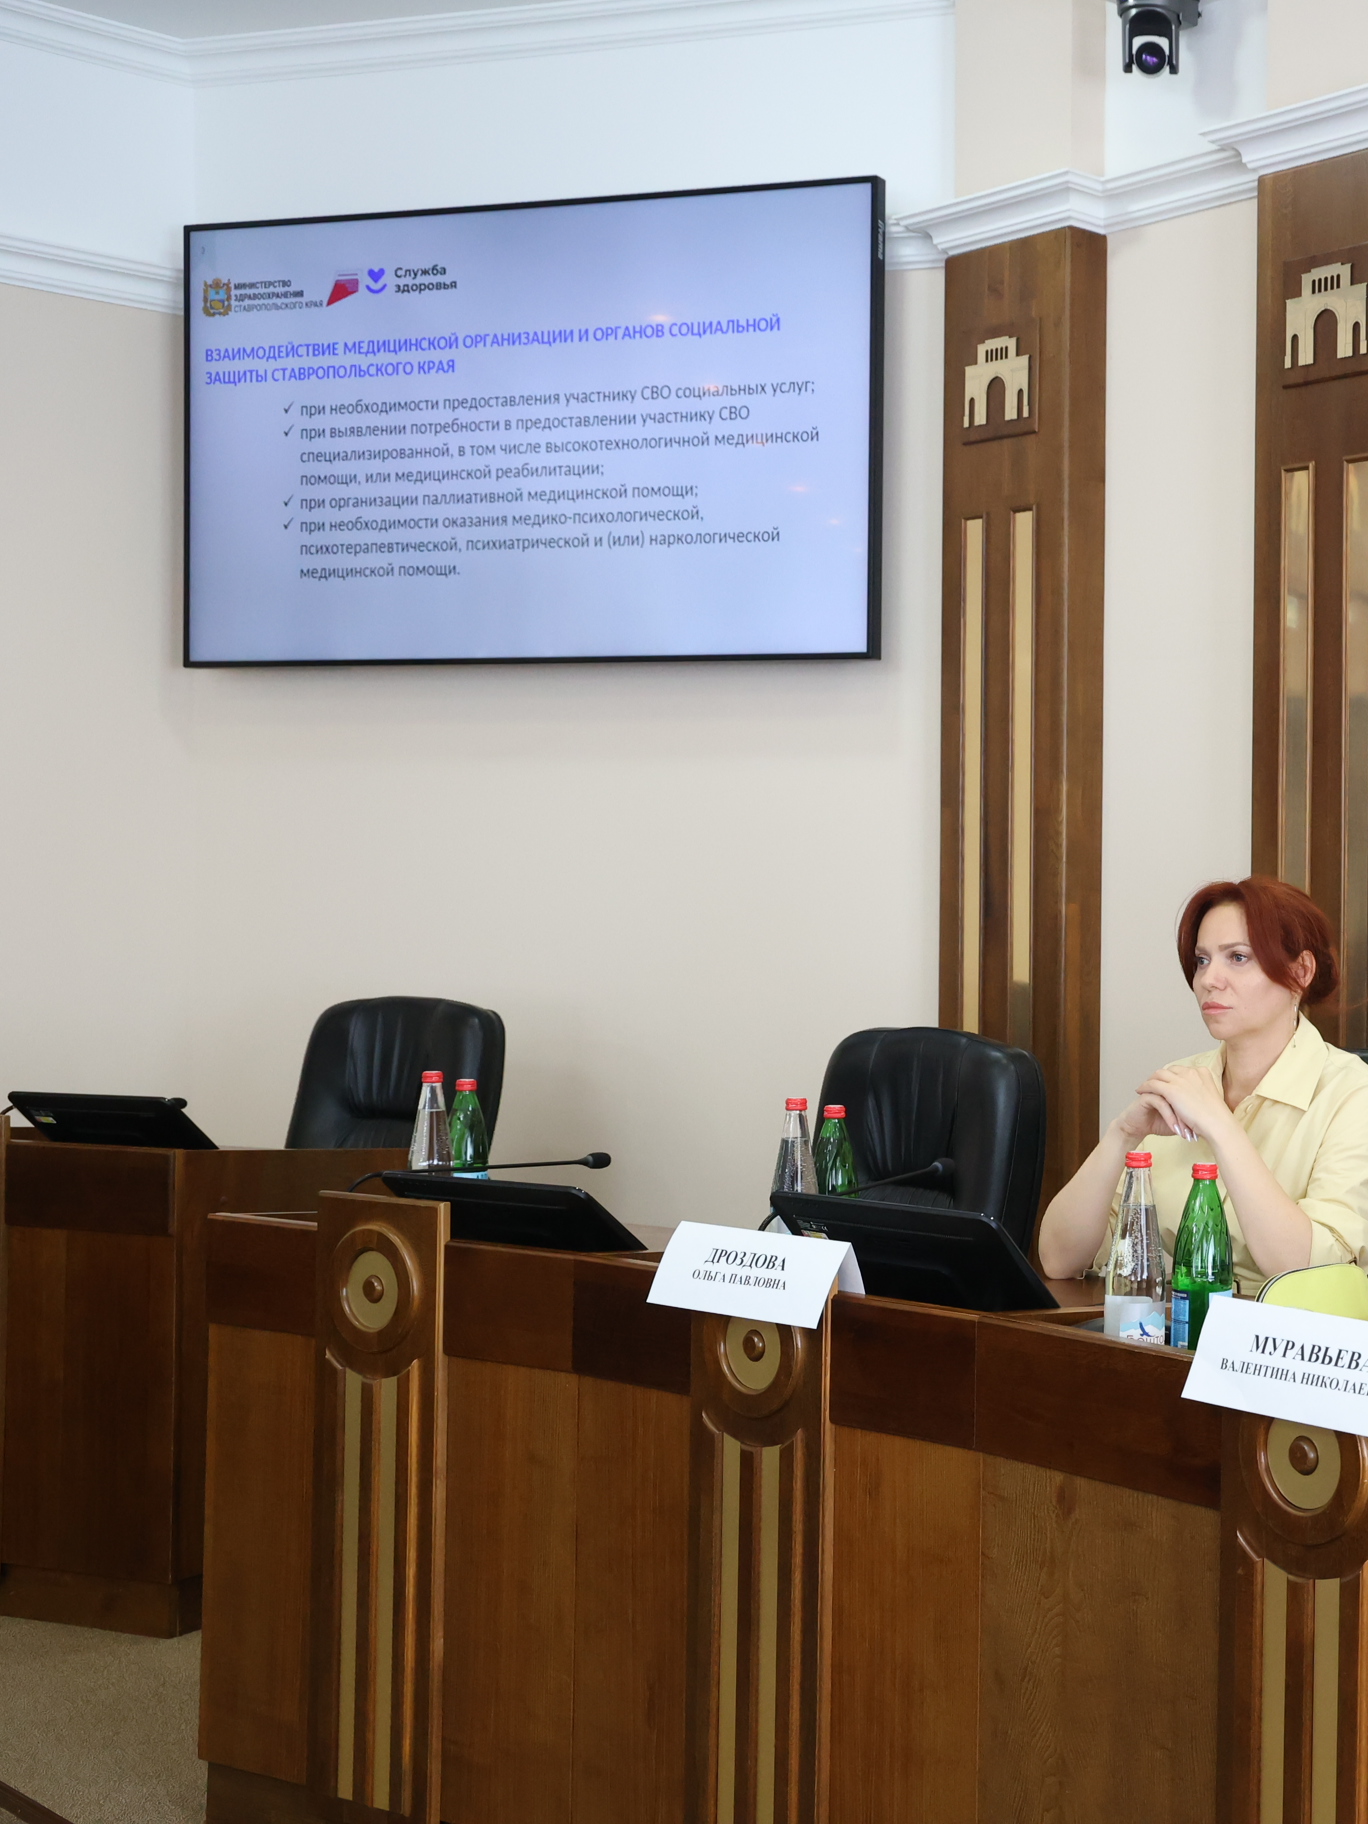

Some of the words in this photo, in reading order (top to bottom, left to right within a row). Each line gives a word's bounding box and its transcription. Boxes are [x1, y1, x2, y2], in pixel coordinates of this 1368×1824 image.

[233, 279, 292, 290] МИНИСТЕРСТВО
[394, 264, 447, 280] Служба
[233, 290, 305, 302] ЗДРАВООХРАНЕНИЯ
[394, 279, 458, 294] здоровья
[233, 301, 303, 313] СТАВРОПОЛЬСКОГО
[305, 299, 324, 308] КРАЯ
[205, 341, 339, 363] ВЗАИМОДЕЙСТВИЕ
[344, 333, 459, 356] МЕДИЦИНСКОЙ
[463, 328, 574, 348] ОРГАНИЗАЦИИ
[578, 328, 589, 342] И
[593, 323, 665, 341] ОРГАНОВ
[669, 314, 781, 337] СОЦИАЛЬНОЙ
[205, 369, 268, 386] ЗАЩИТЫ
[272, 362, 414, 382] СТАВРОПОЛЬСКОГО
[418, 359, 455, 374] КРАЯ
[300, 404, 325, 417] при
[330, 399, 439, 415] необходимости
[443, 394, 560, 412] предоставления
[564, 389, 637, 406] участнику
[641, 385, 672, 400] СВО
[676, 382, 767, 400] социальных
[771, 379, 815, 398] услуг;
[300, 428, 325, 441] при
[330, 424, 406, 438] выявлении
[411, 417, 500, 436] потребности
[505, 419, 512, 431] в
[516, 413, 637, 432] предоставлении
[640, 409, 715, 427] участнику
[719, 405, 750, 421] СВО
[300, 442, 454, 464] специализированной,
[458, 445, 466, 456] в
[470, 444, 496, 456] том
[500, 442, 542, 454] числе
[546, 431, 710, 453] высокотехнологичной
[715, 426, 820, 447] медицинской
[300, 473, 361, 487] помощи,
[365, 472, 391, 483] или
[395, 465, 492, 485] медицинской
[496, 463, 605, 482] реабилитации;
[300, 498, 325, 511] при
[329, 495, 418, 511] организации
[423, 487, 523, 506] паллиативной
[528, 484, 628, 504] медицинской
[632, 483, 699, 500] помощи;
[300, 521, 325, 534] при
[330, 515, 439, 532] необходимости
[443, 515, 508, 528] оказания
[512, 504, 704, 528] медико-психологической,
[300, 537, 462, 557] психотерапевтической,
[466, 532, 590, 552] психиатрической
[594, 537, 603, 547] и
[608, 530, 645, 549] (или)
[649, 527, 781, 548] наркологической
[300, 563, 395, 581] медицинской
[399, 565, 461, 579] помощи.
[703, 1247, 787, 1272] ДРОЗДОВА
[692, 1269, 726, 1283] ОЛЬГА
[728, 1274, 787, 1291] ПАВЛОВНА
[1220, 1357, 1297, 1383] ВАЛЕНТИНА
